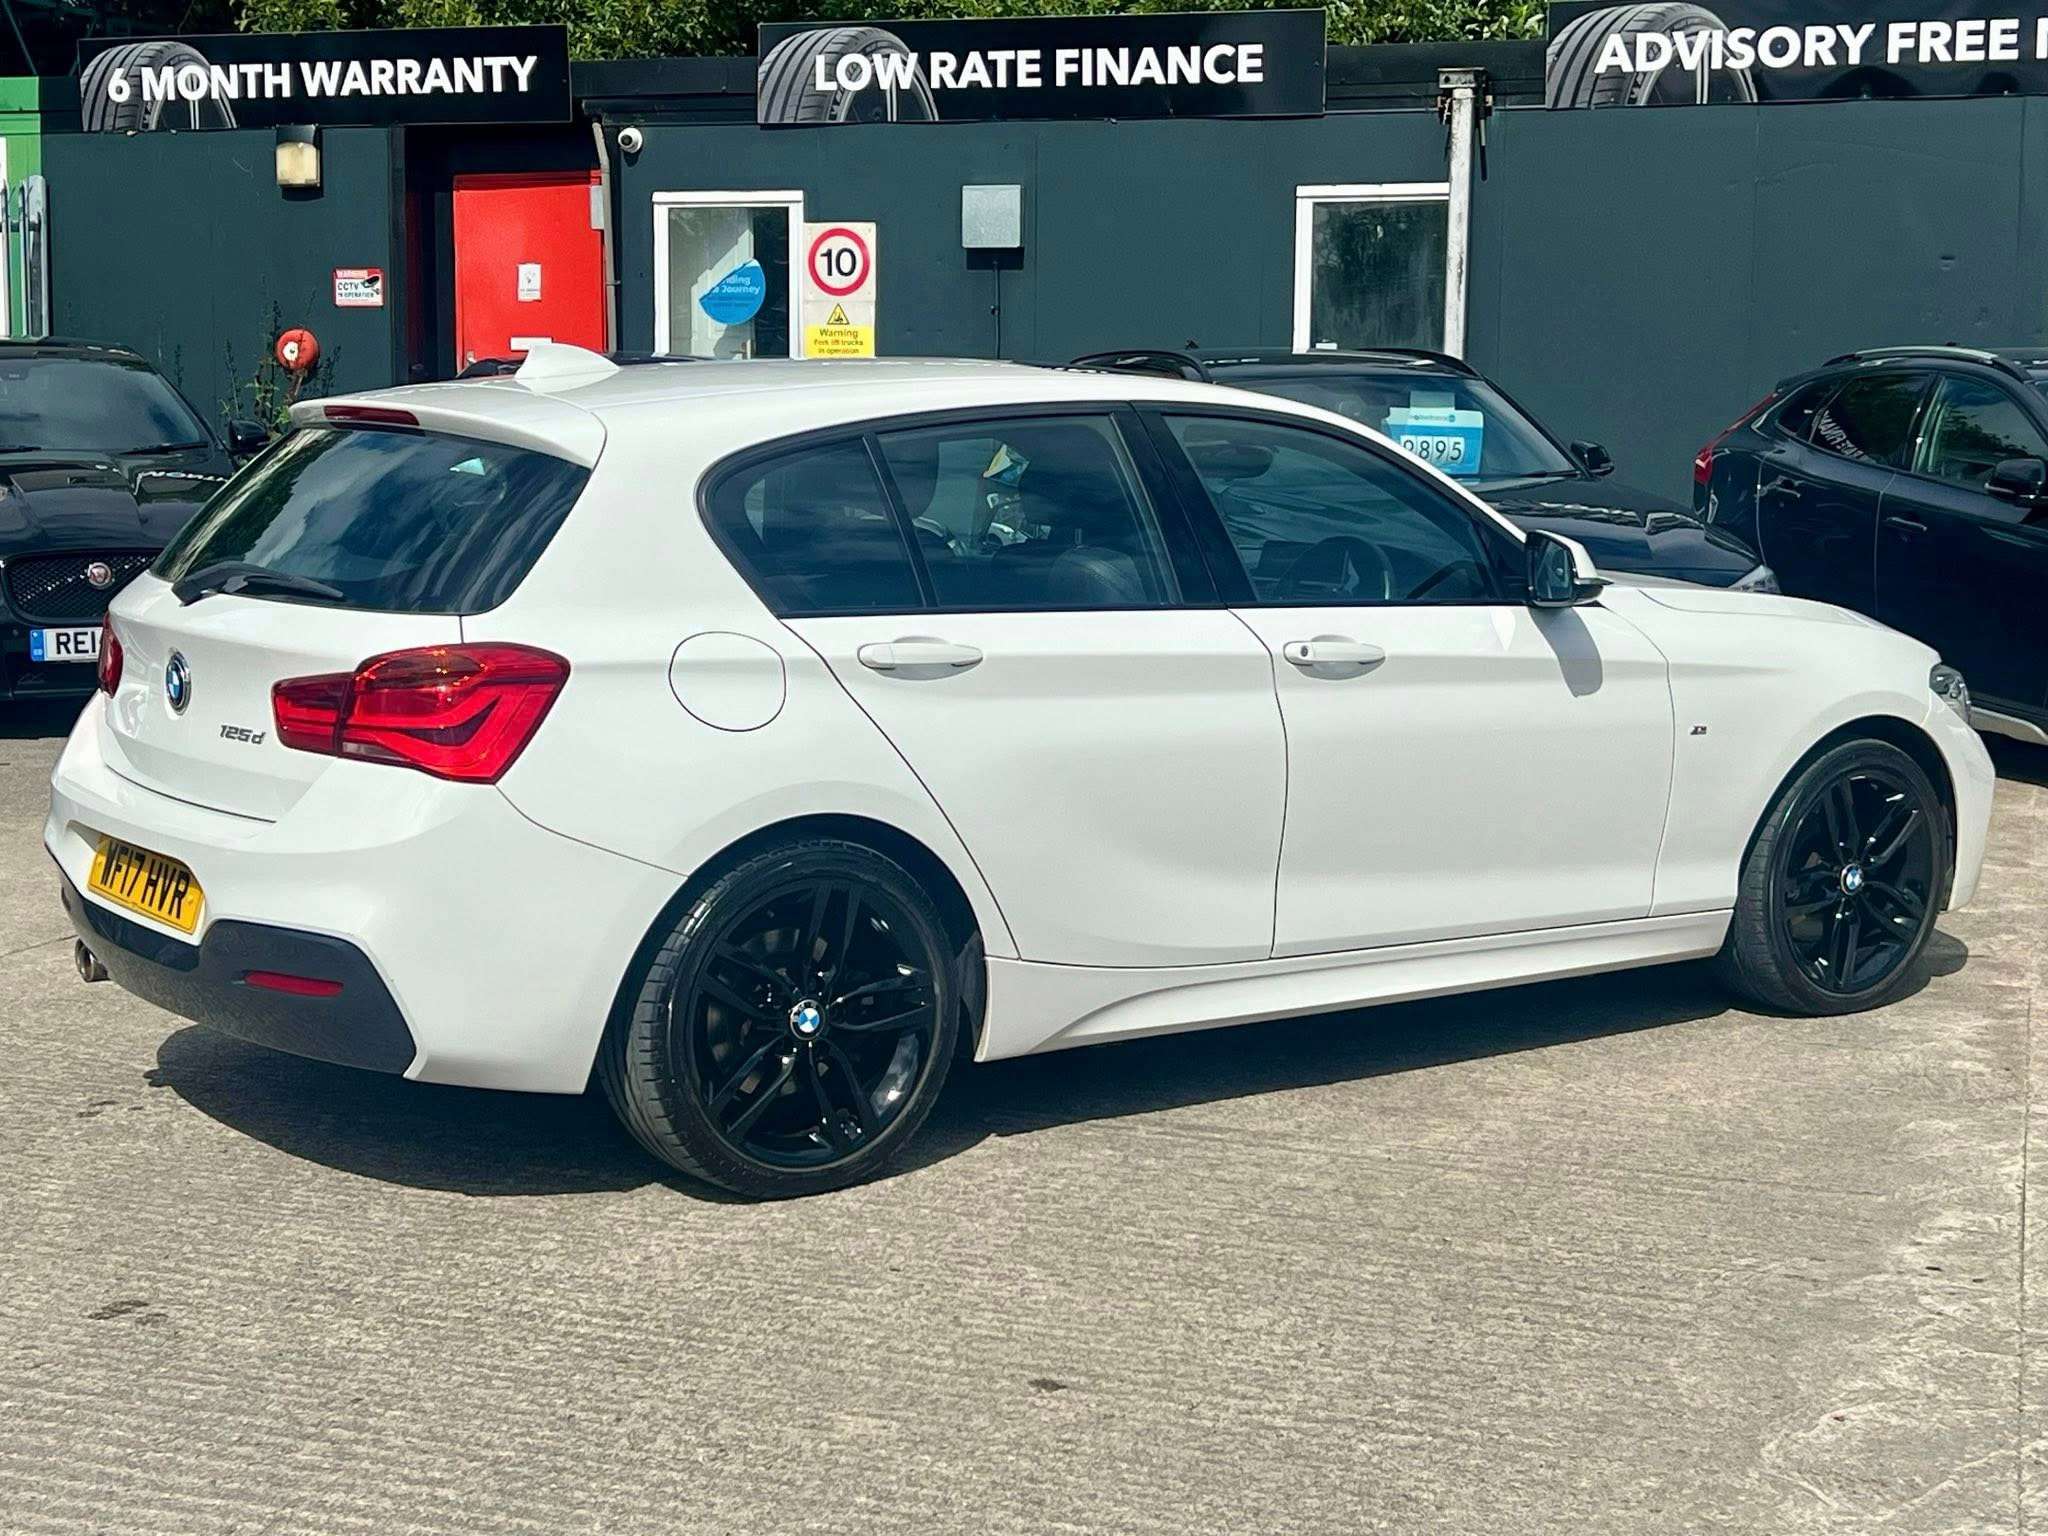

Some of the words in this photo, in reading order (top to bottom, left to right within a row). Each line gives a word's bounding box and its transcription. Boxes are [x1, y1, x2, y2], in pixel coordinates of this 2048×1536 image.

[1594, 22, 1837, 74] ADVISORY
[1887, 18, 2020, 63] FREE
[107, 67, 131, 103] 6
[141, 61, 291, 102] MONTH
[301, 55, 538, 98] WARRANTY
[815, 52, 918, 92] LOW
[931, 49, 1042, 89] RATE
[1055, 44, 1264, 87] FINANCE
[820, 247, 857, 277] 10
[337, 282, 359, 291] CCTV
[721, 285, 761, 295] Journey
[819, 328, 859, 339] Warning
[220, 725, 267, 744] 125d
[141, 859, 191, 920] HVR
